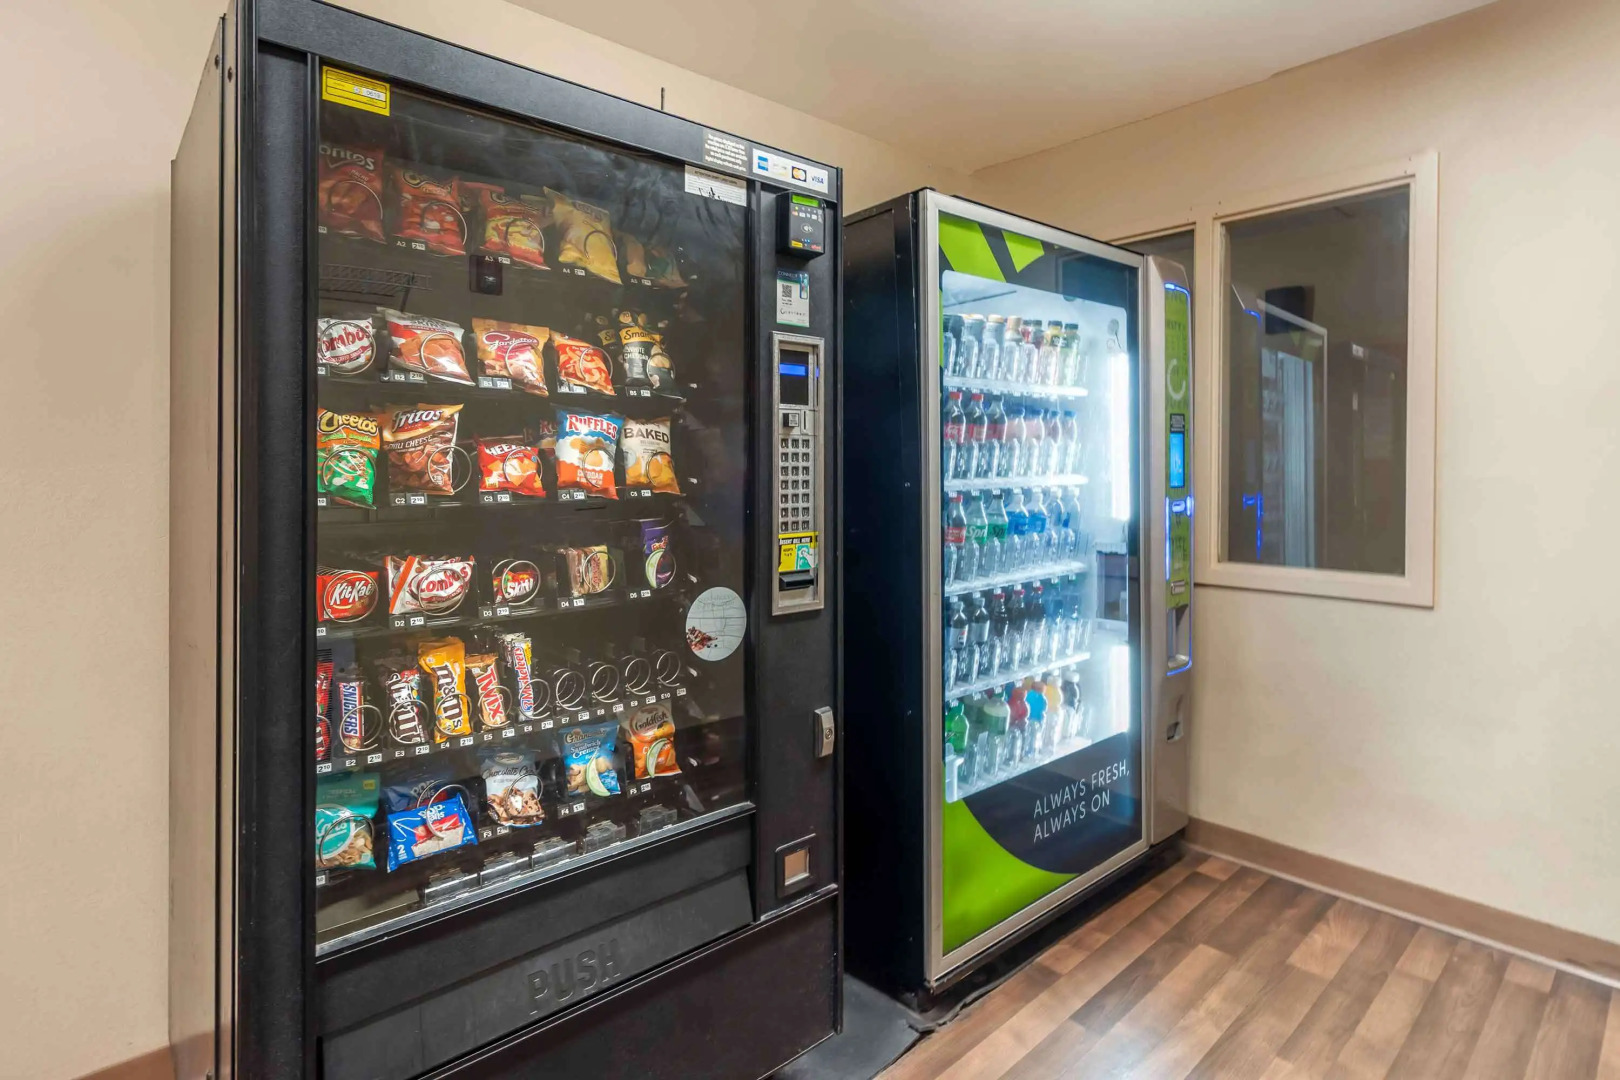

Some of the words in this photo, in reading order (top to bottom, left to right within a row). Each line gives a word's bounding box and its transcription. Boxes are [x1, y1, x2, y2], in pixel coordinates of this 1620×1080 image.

[318, 145, 375, 171] oritos
[319, 411, 378, 434] Cheetos
[567, 414, 619, 441] RUFFLES
[624, 428, 669, 444] BAKED
[342, 683, 359, 736] SNICKERS
[561, 716, 570, 724] E7
[634, 711, 669, 731] Goldfish
[440, 741, 450, 749] E4
[483, 733, 493, 741] E5
[395, 750, 405, 758] E3
[1033, 778, 1086, 818] ALWAYS
[1091, 759, 1130, 791] FRESH,
[1033, 801, 1086, 843] ALWAYS
[1091, 789, 1110, 813] ON
[397, 844, 406, 854] 2
[527, 938, 621, 1015] PUSH
